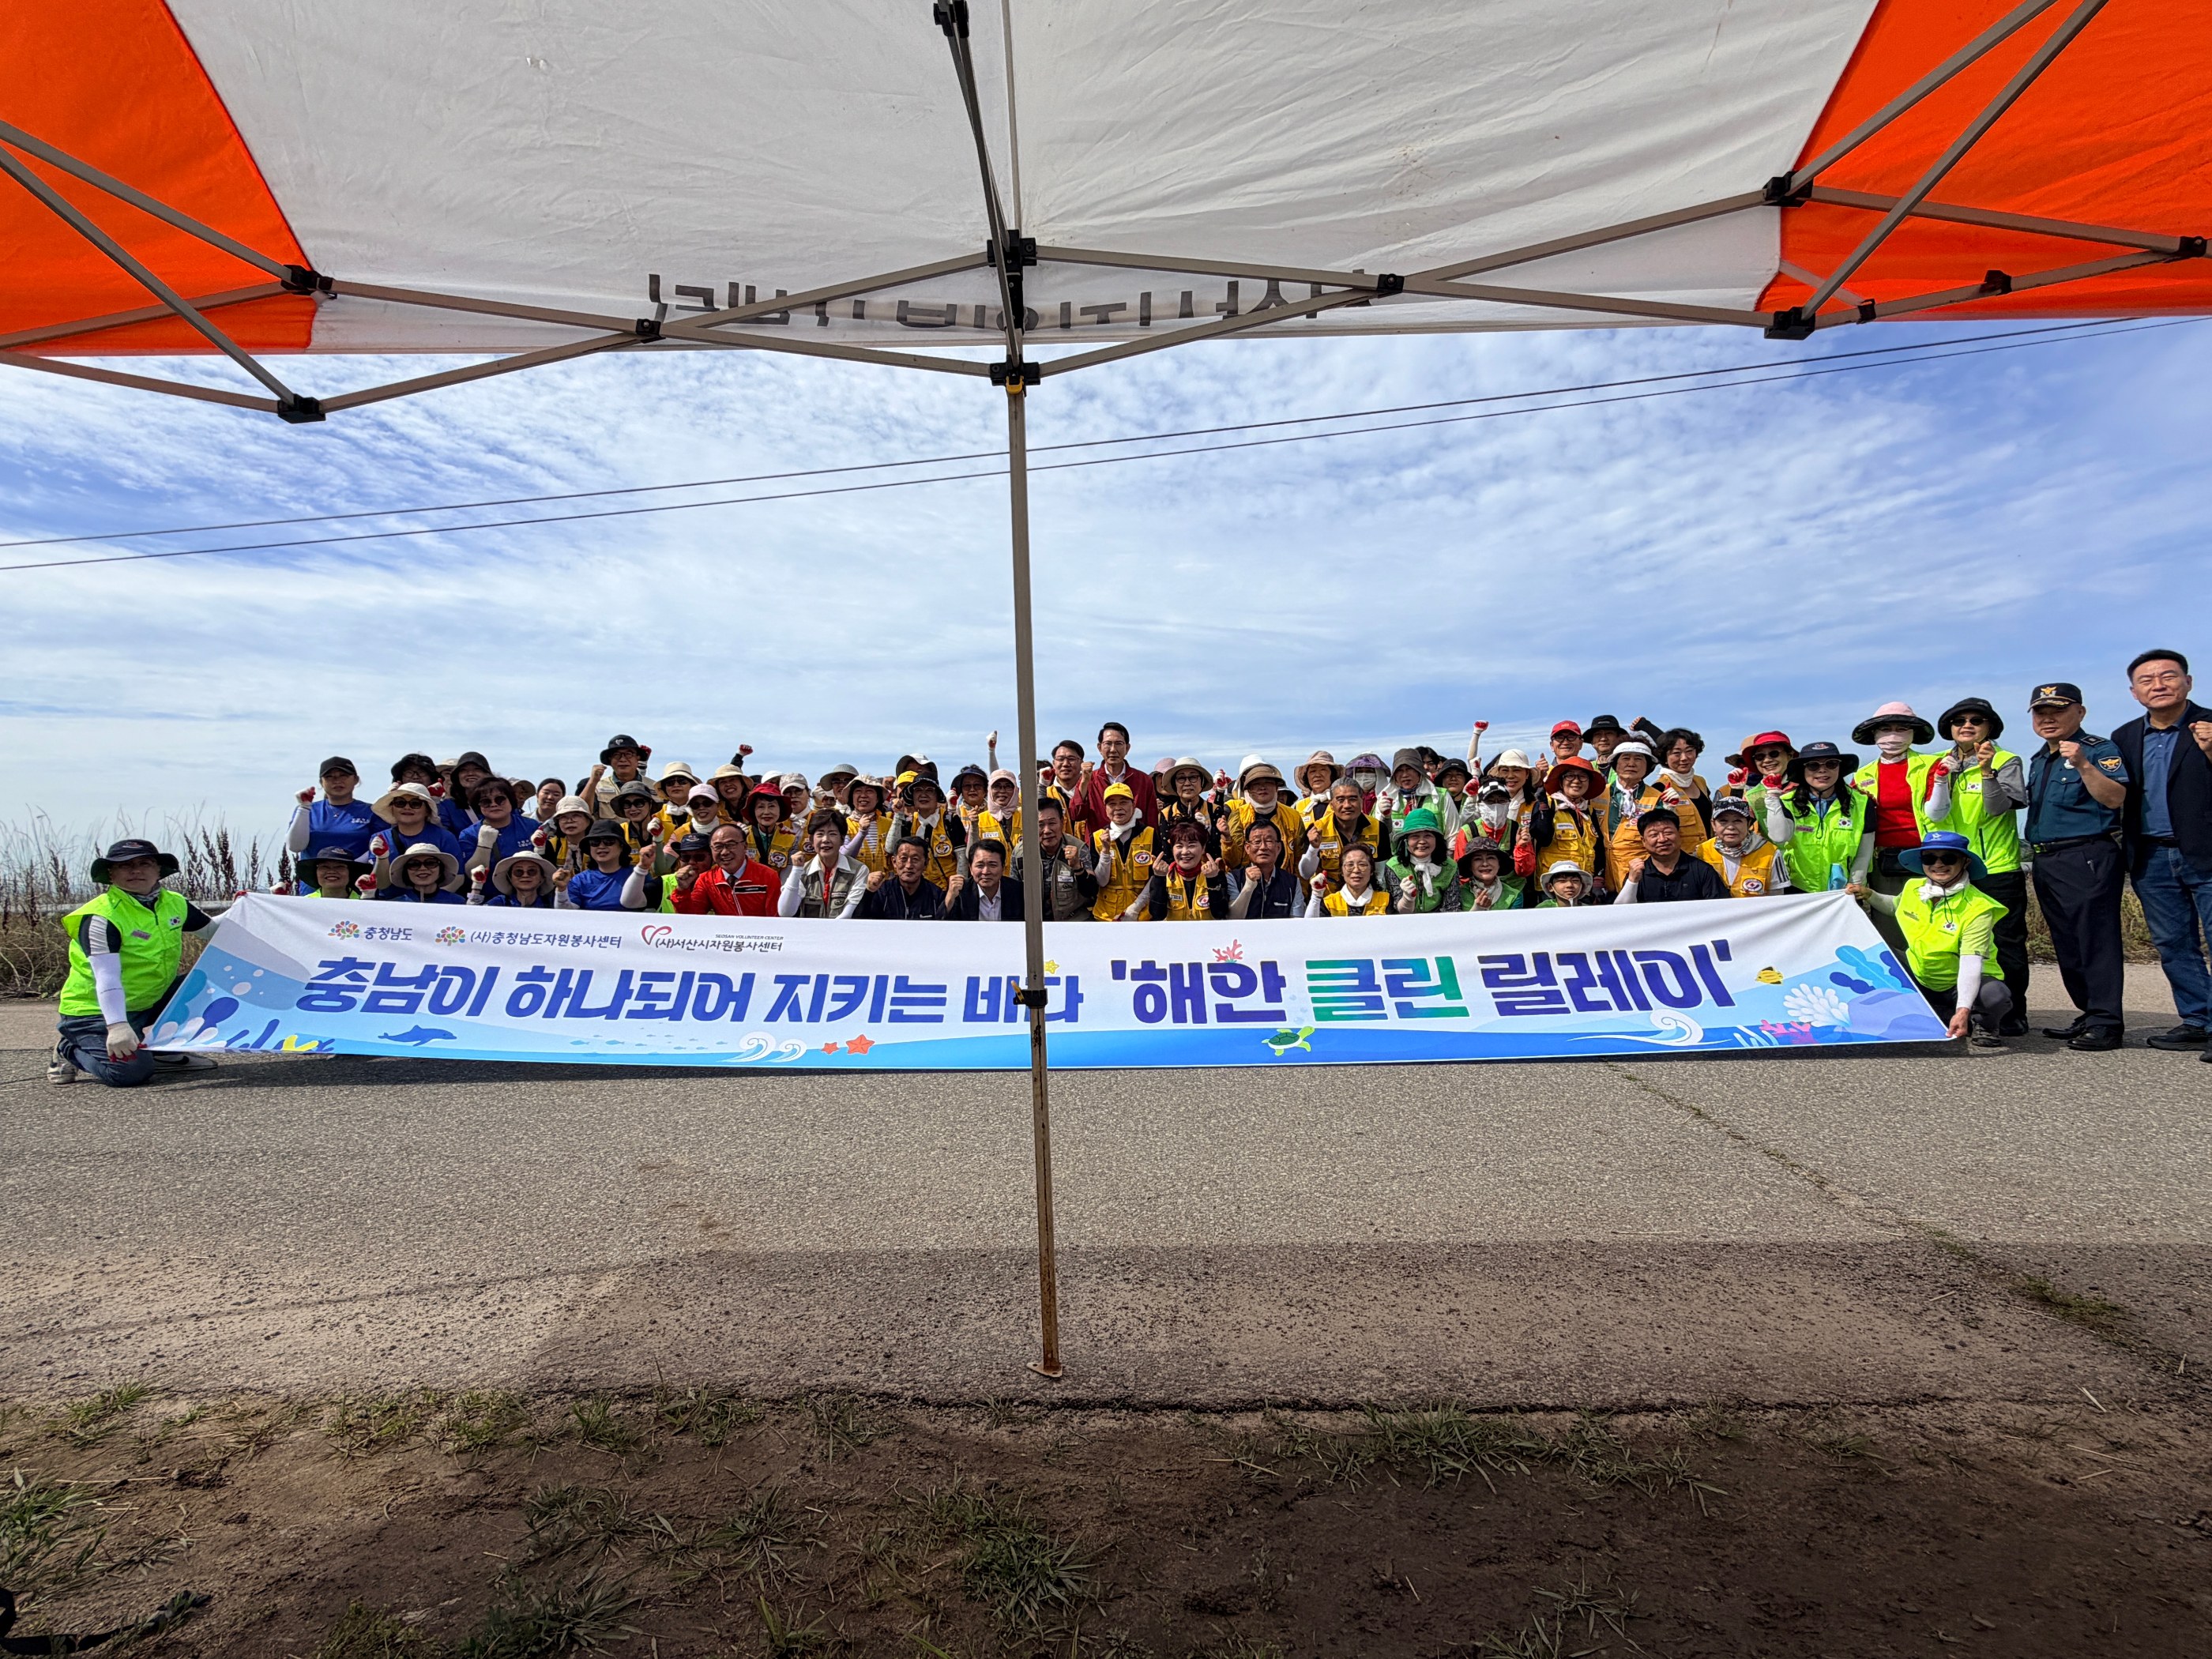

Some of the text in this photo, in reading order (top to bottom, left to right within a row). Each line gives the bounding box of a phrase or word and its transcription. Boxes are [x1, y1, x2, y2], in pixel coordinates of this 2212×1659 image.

[363, 926, 413, 942] 충청남도
[469, 930, 623, 949] (사)충청남도자원봉사센터
[655, 938, 784, 953] (사)서산시자원봉사센터
[295, 956, 499, 1017] 충남이
[506, 965, 755, 1022] 하나되어
[763, 973, 948, 1023] 지키는
[962, 975, 1084, 1023] 바다
[1305, 956, 1470, 1021] 클린
